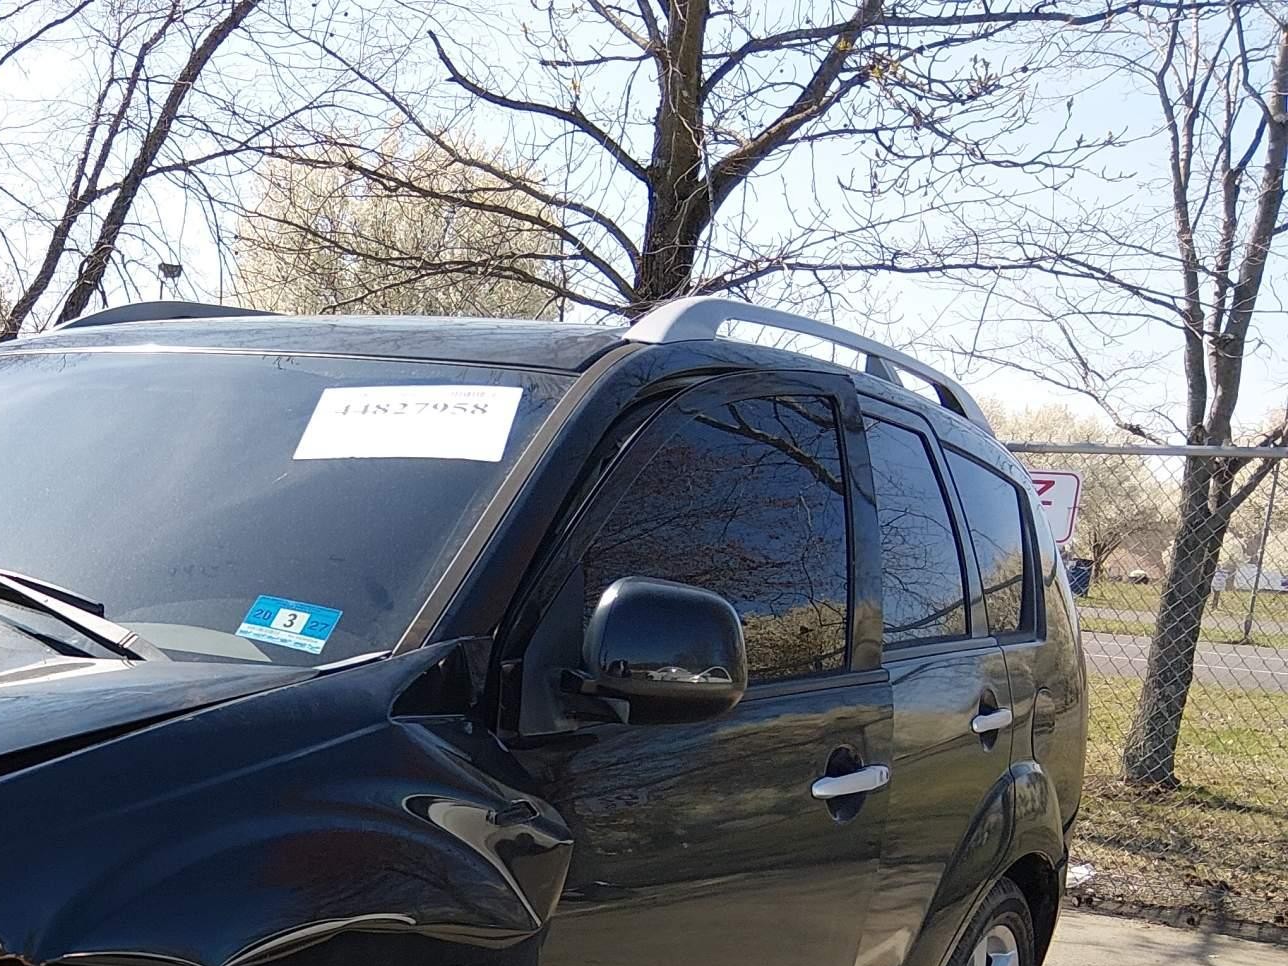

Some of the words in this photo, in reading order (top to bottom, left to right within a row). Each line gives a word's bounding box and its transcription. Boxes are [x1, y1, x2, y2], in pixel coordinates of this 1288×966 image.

[334, 402, 489, 415] 44827958
[254, 608, 273, 621] 20
[283, 613, 298, 628] 3
[308, 620, 330, 633] 27
